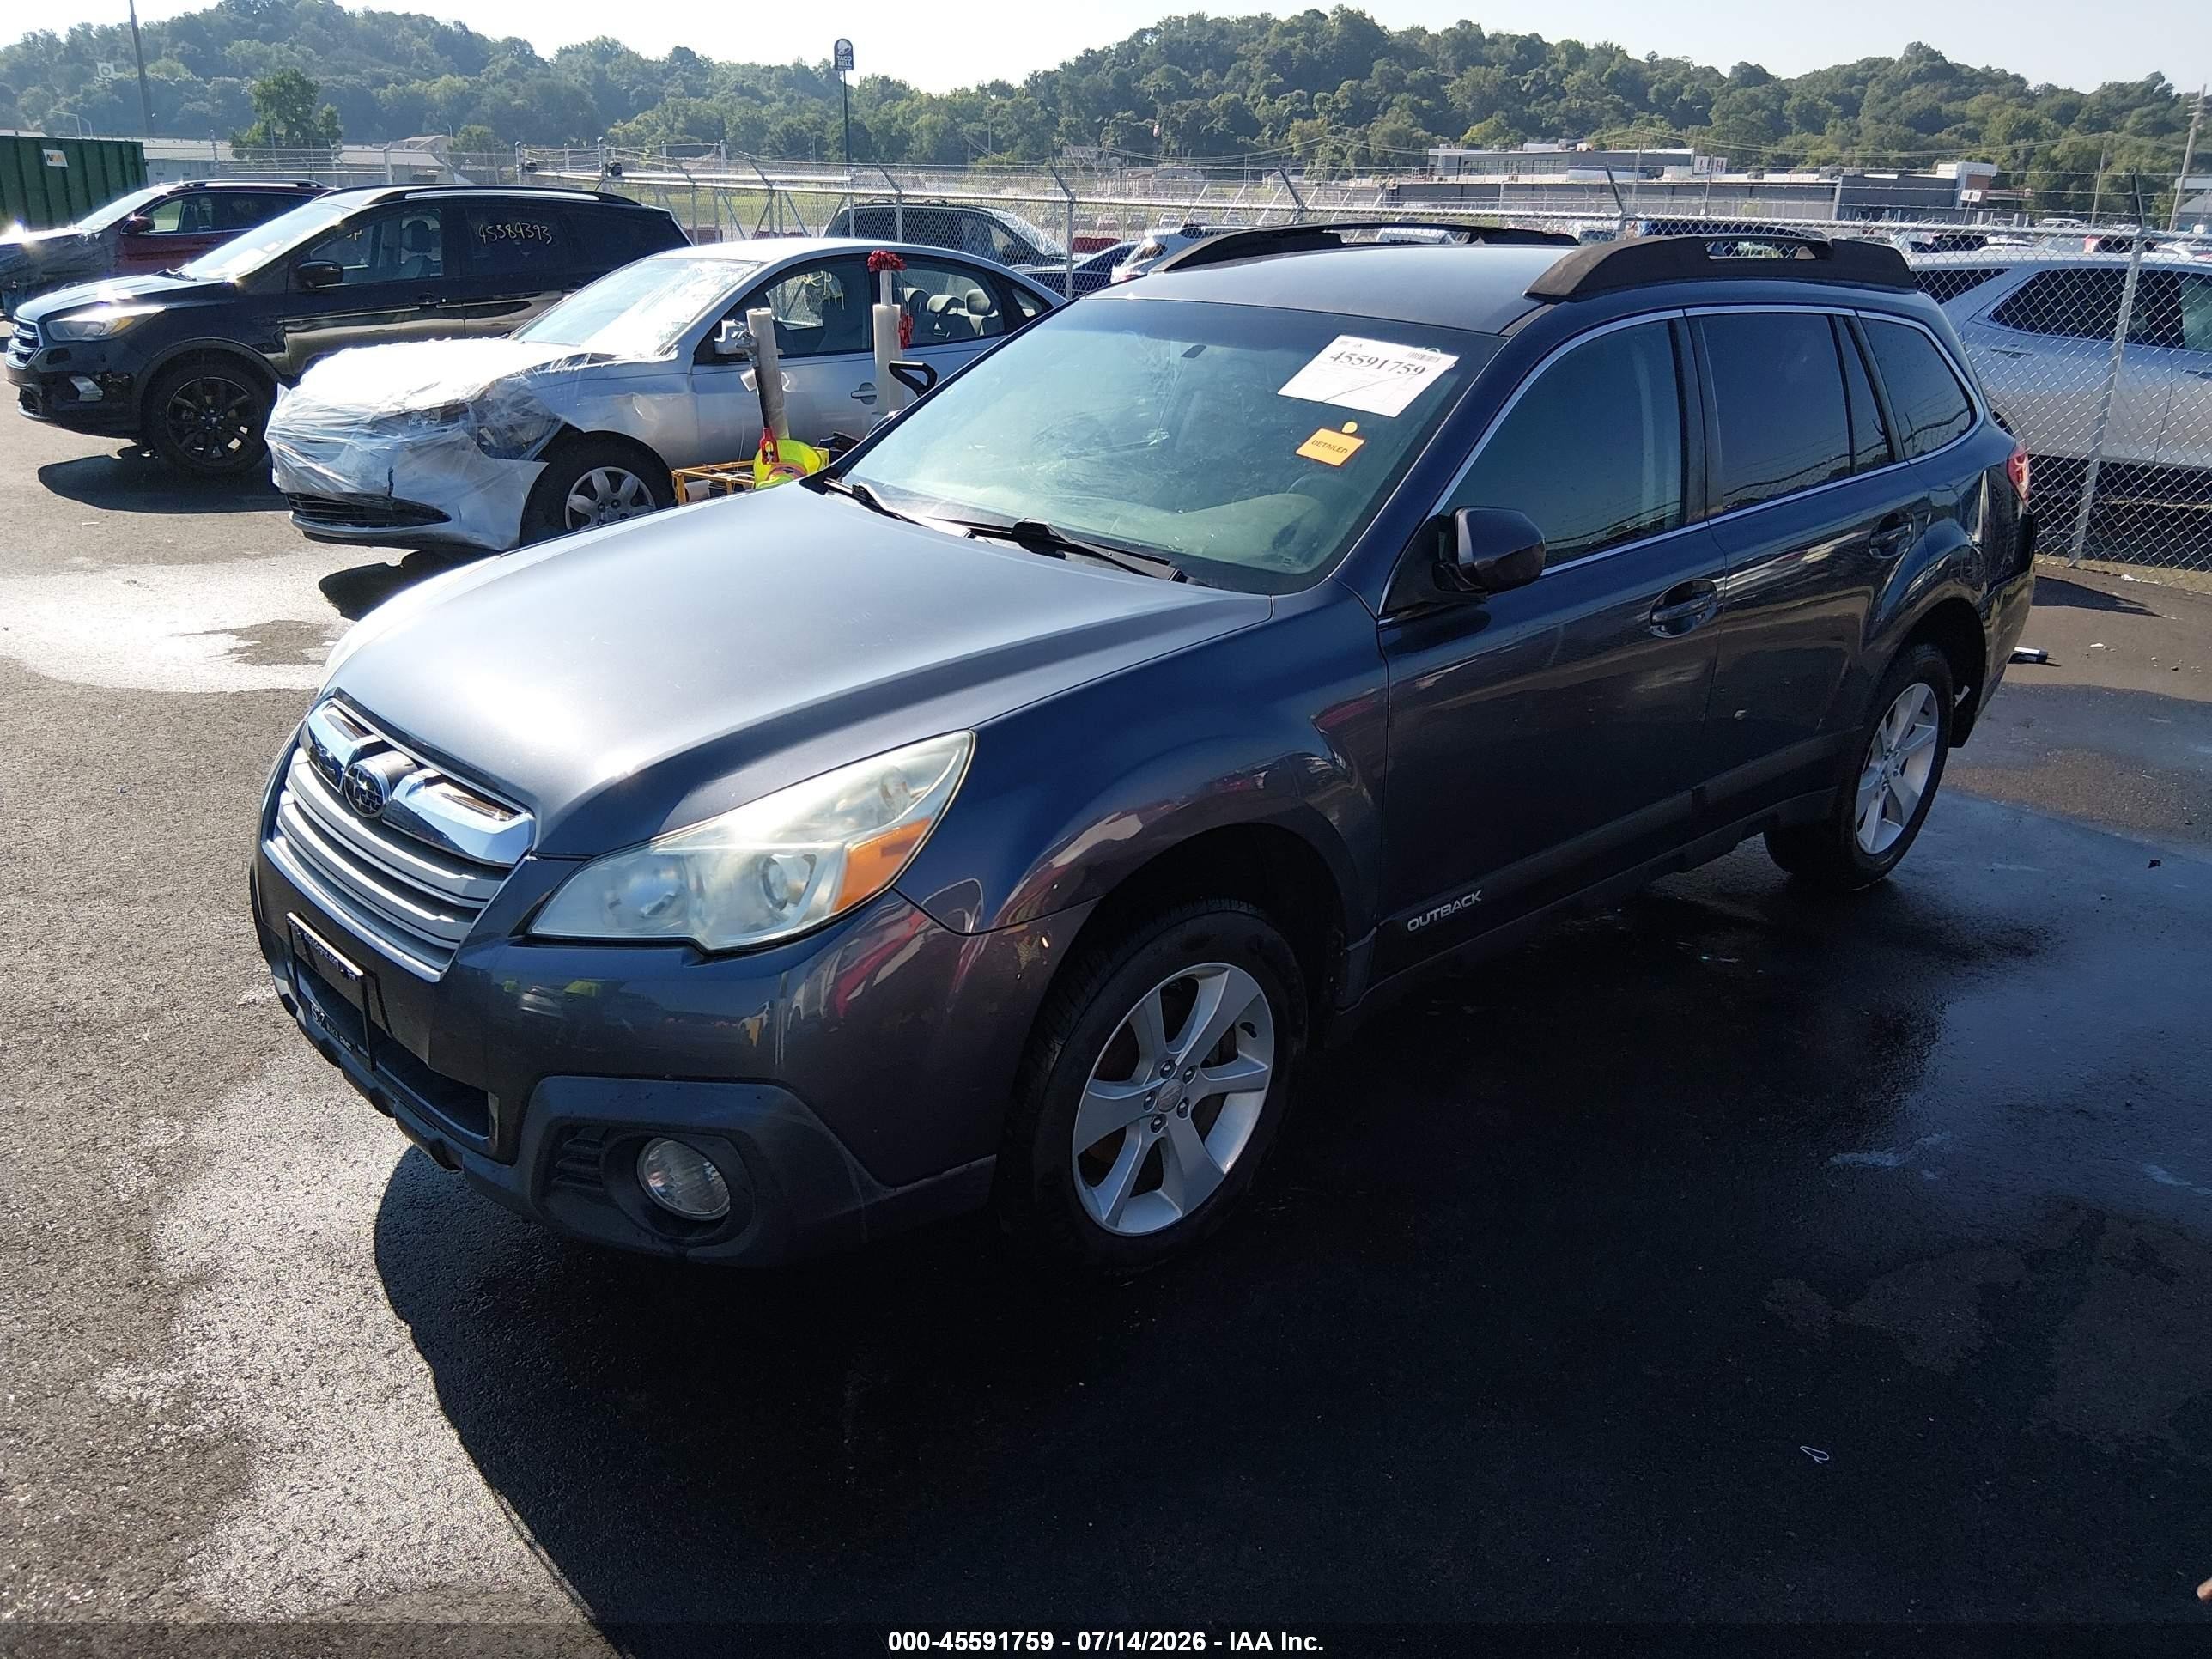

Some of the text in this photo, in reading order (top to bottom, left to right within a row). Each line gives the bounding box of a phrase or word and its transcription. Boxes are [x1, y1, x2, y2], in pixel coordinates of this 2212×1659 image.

[1329, 350, 1427, 375] 45591759
[1311, 439, 1348, 454] DETAILED
[1407, 888, 1483, 933] OUTBACK
